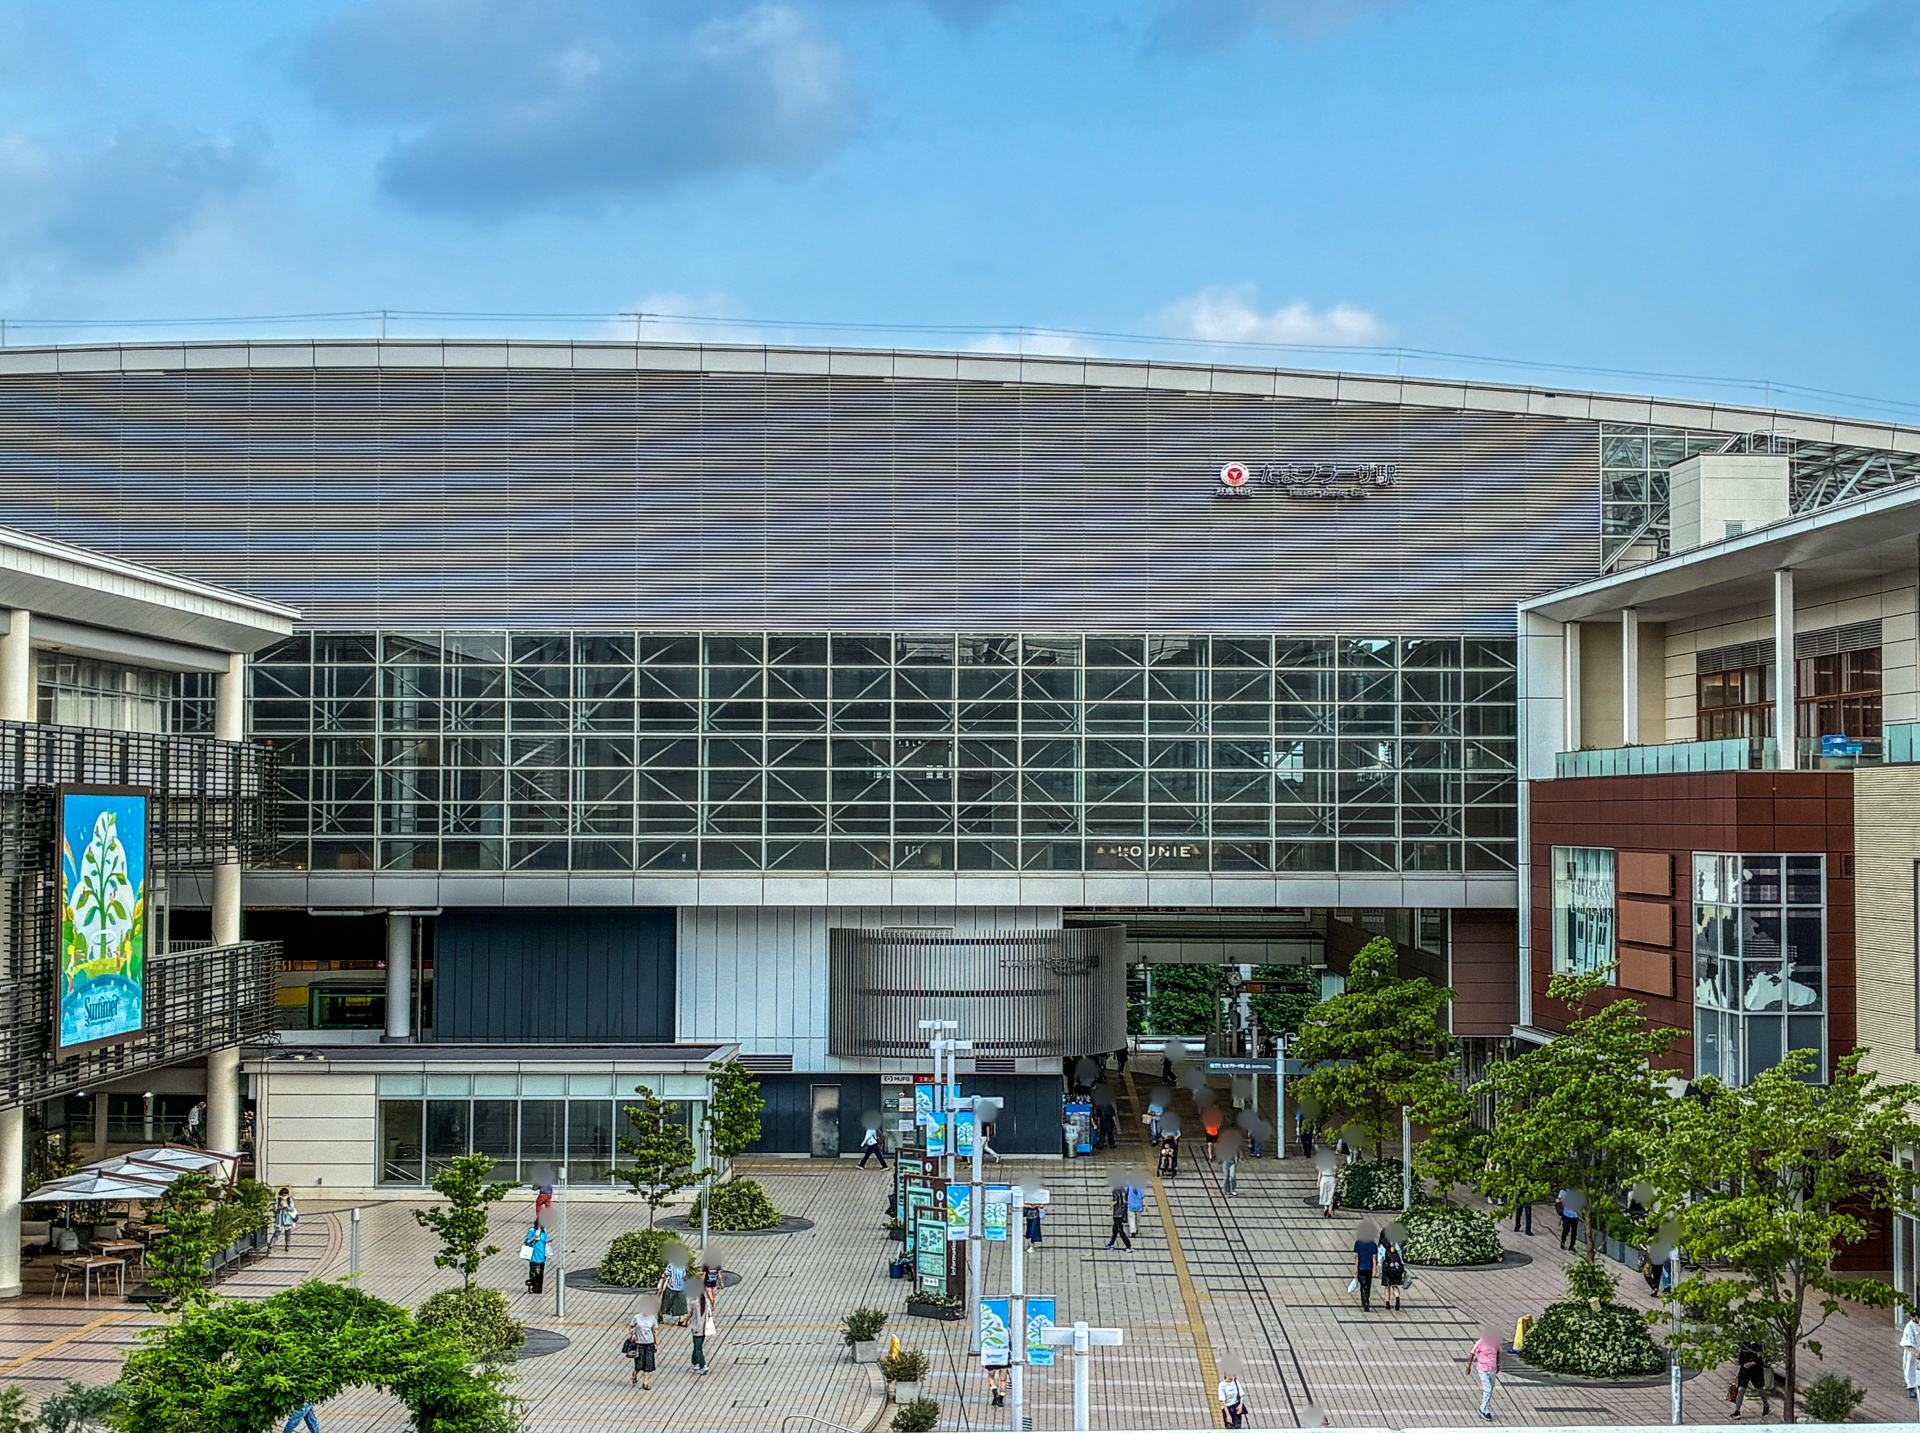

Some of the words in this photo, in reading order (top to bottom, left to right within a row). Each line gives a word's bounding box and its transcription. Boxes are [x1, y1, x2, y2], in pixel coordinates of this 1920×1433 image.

[1260, 463, 1397, 486] たまプラーザ駅
[84, 993, 120, 1027] Summer
